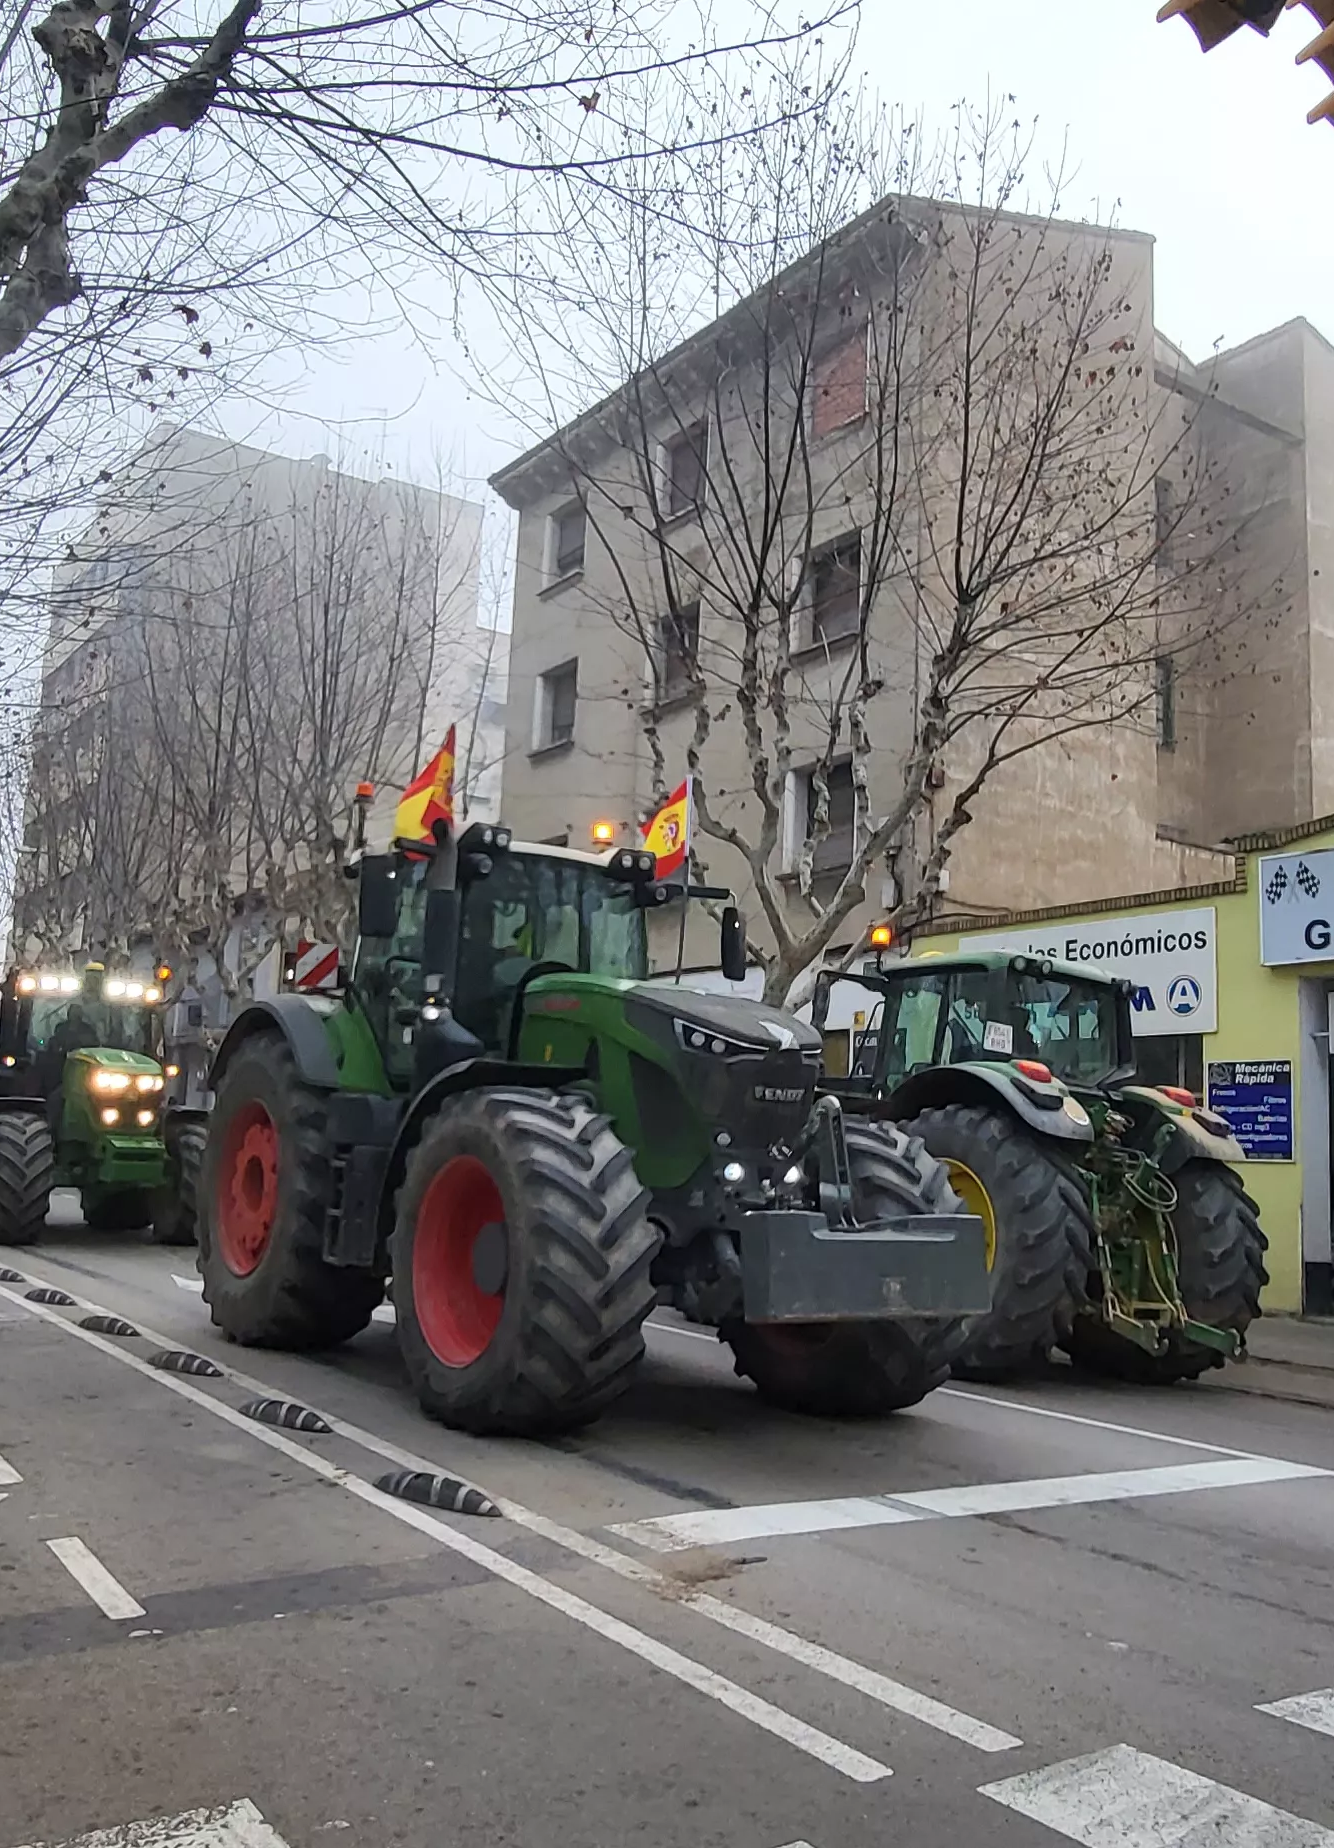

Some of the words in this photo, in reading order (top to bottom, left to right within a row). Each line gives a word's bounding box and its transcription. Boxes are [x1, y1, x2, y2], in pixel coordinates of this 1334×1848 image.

[1065, 929, 1208, 962] Económicos
[1235, 1062, 1290, 1073] Mecánica
[754, 1086, 805, 1101] FENDT
